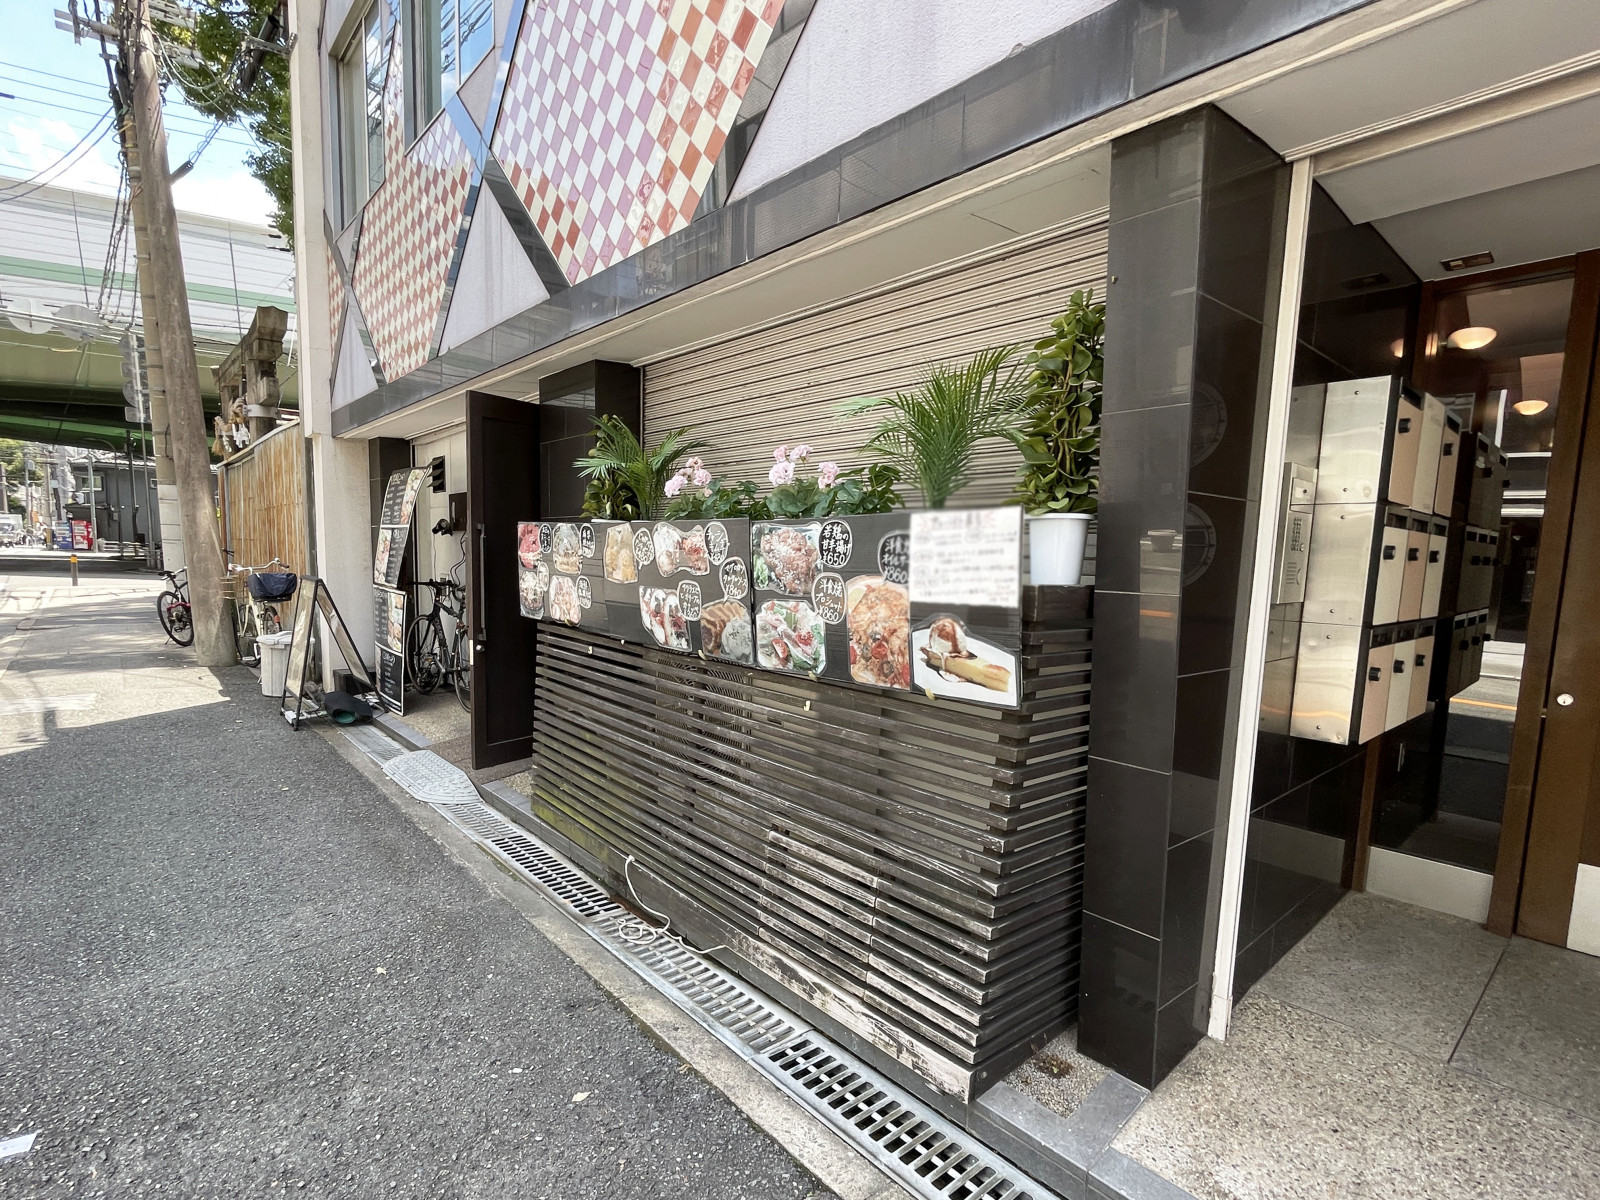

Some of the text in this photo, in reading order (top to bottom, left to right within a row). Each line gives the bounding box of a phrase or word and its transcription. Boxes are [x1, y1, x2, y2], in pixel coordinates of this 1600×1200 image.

[822, 523, 848, 541] 若鶏の
[822, 550, 845, 566] ¥650
[884, 565, 907, 583] ¥860
[818, 578, 842, 598] 洋食焼
[815, 592, 843, 613] プロシュット
[819, 604, 839, 622] ¥860
